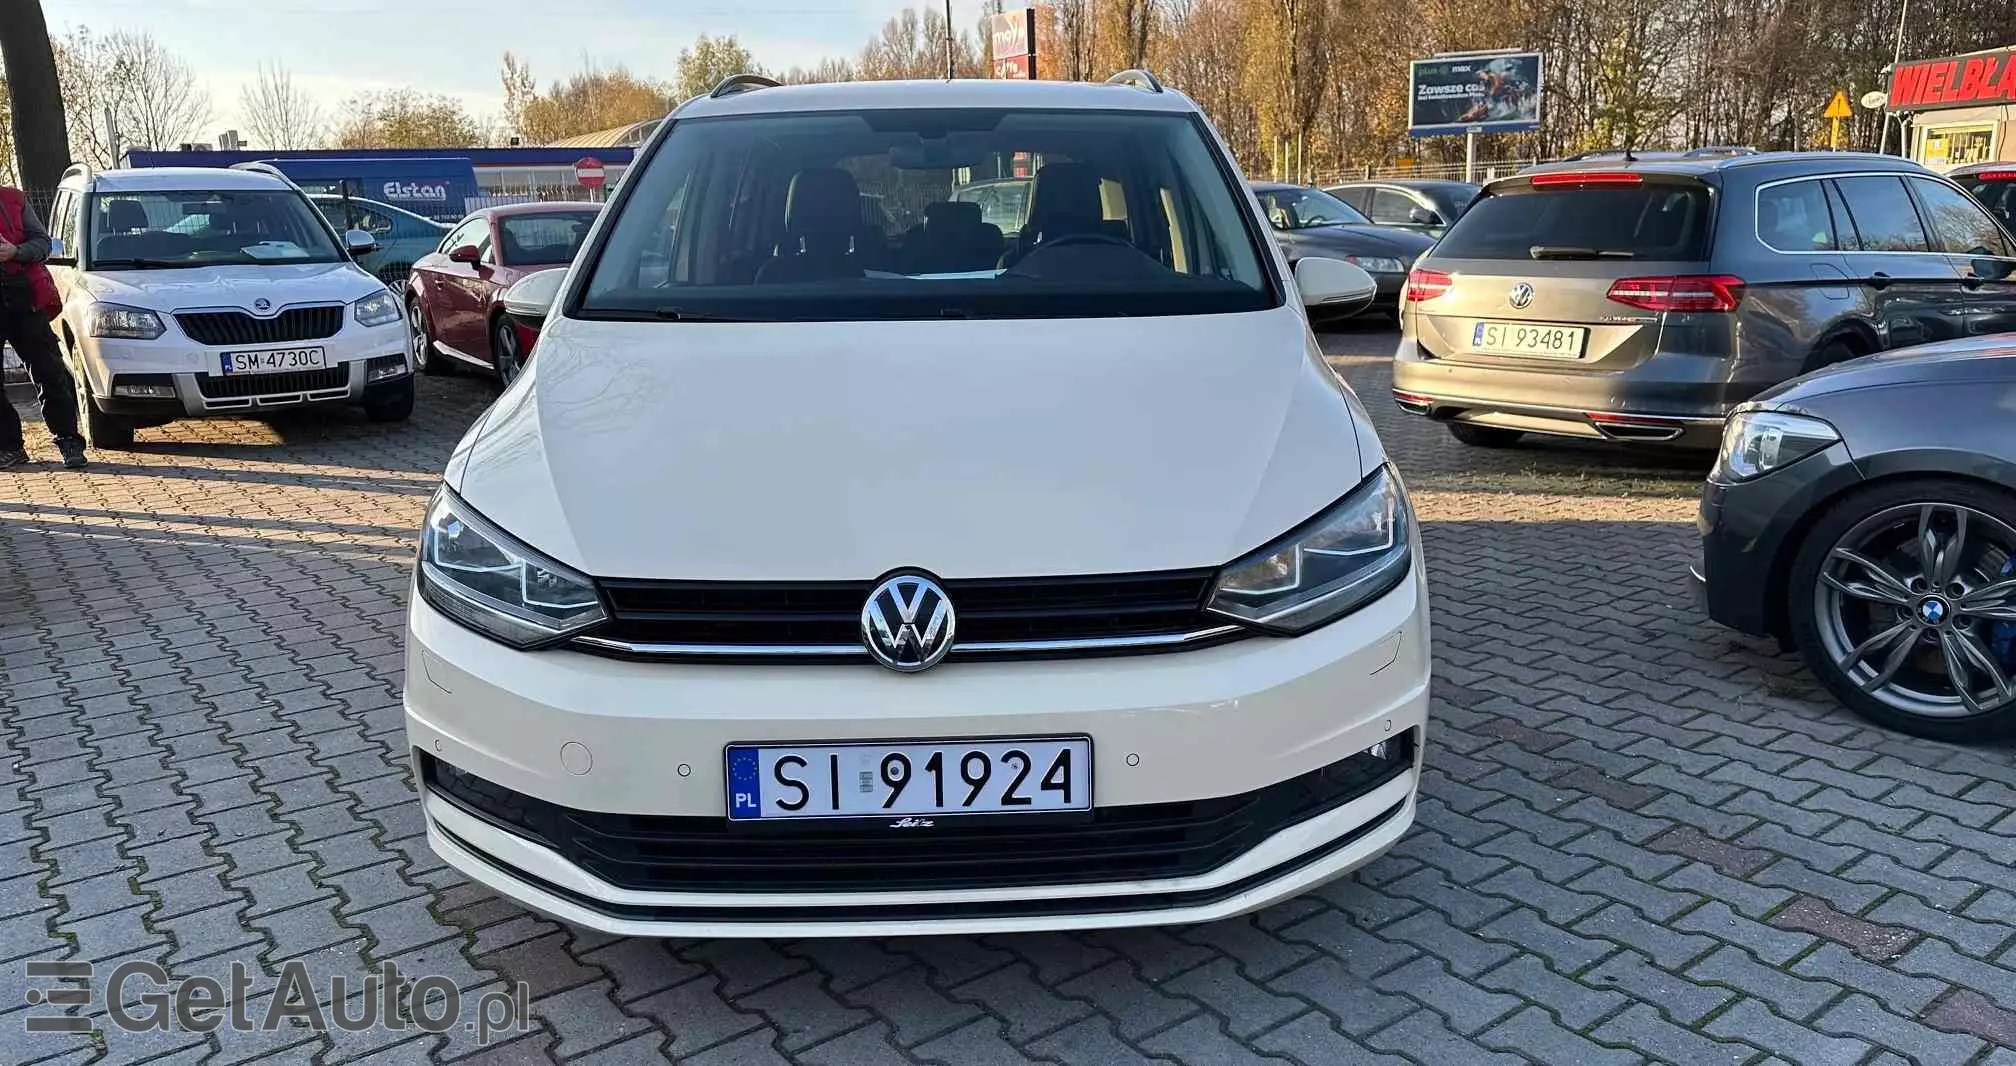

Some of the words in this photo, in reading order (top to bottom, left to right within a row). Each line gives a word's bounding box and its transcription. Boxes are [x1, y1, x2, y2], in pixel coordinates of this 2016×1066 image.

[1452, 64, 1472, 73] max
[1418, 83, 1464, 95] Zawsze
[383, 181, 447, 201] Elstan
[1486, 326, 1507, 348] SI
[1515, 328, 1575, 351] 93481
[235, 353, 260, 371] SM
[266, 349, 320, 368] 4730C
[773, 752, 840, 812] SI
[880, 748, 1074, 809] 91924
[735, 792, 757, 808] PL
